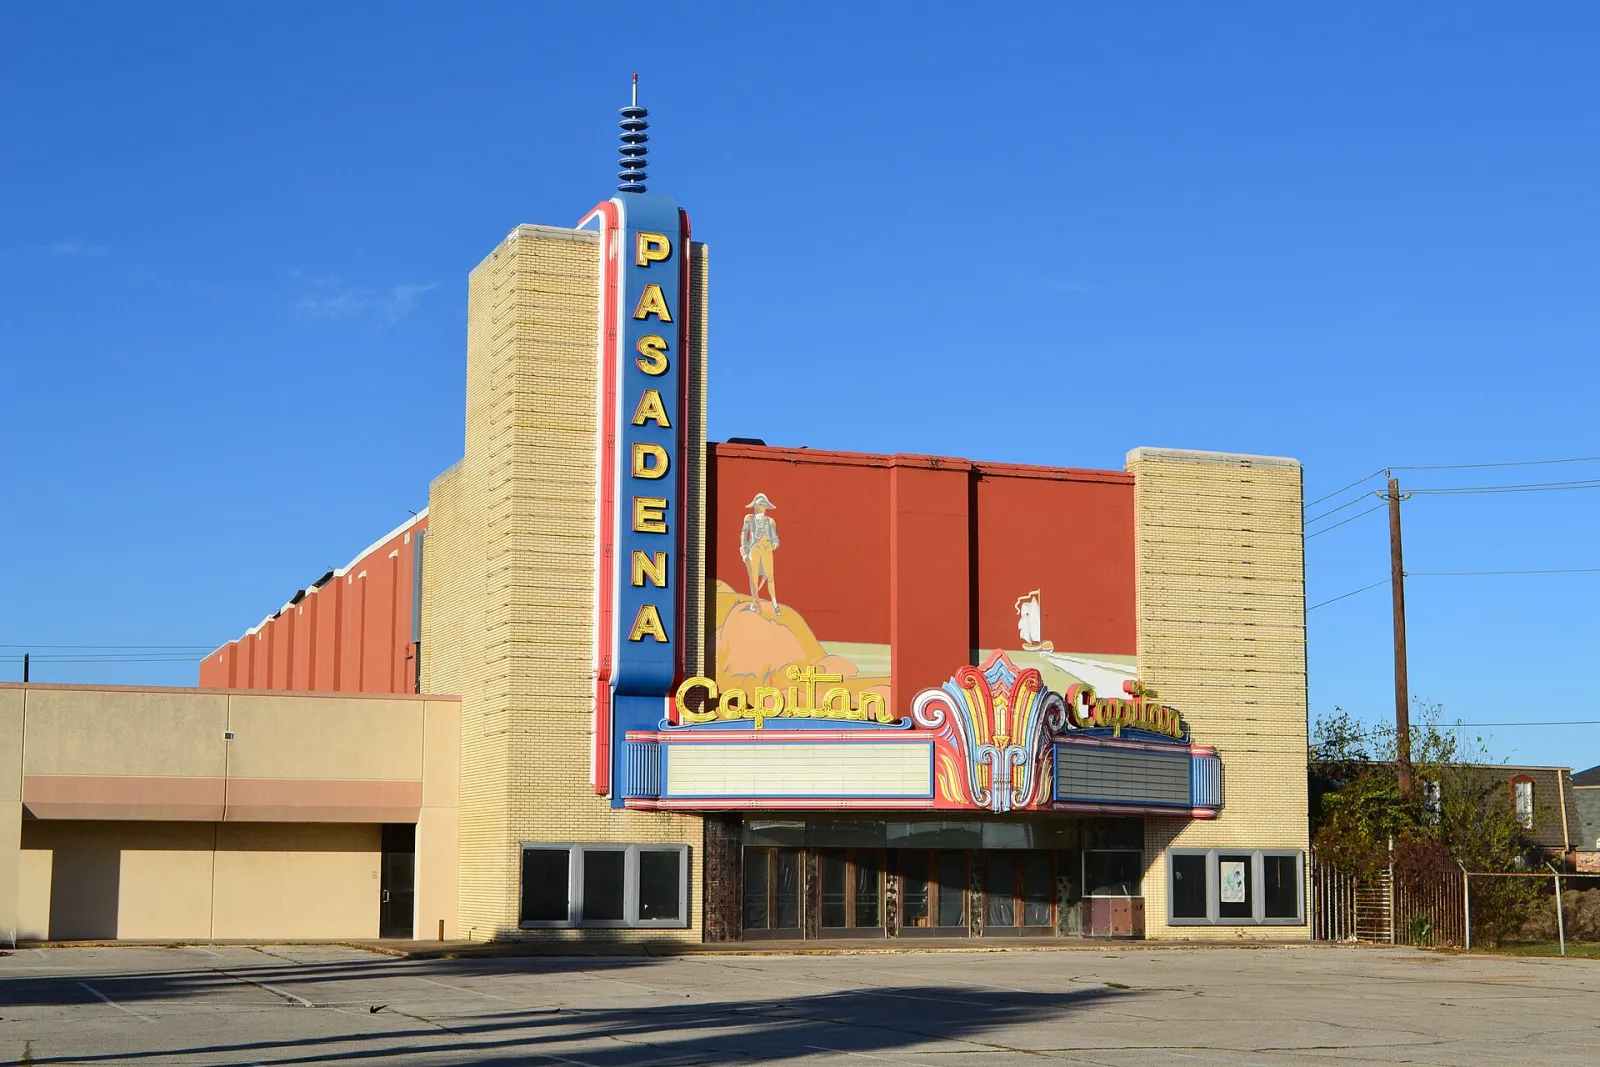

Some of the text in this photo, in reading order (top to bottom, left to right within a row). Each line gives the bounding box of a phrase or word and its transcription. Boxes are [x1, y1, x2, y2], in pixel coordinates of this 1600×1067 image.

[628, 231, 672, 643] PASADENA
[675, 666, 894, 730] Capitan
[1066, 680, 1184, 738] Capitan
